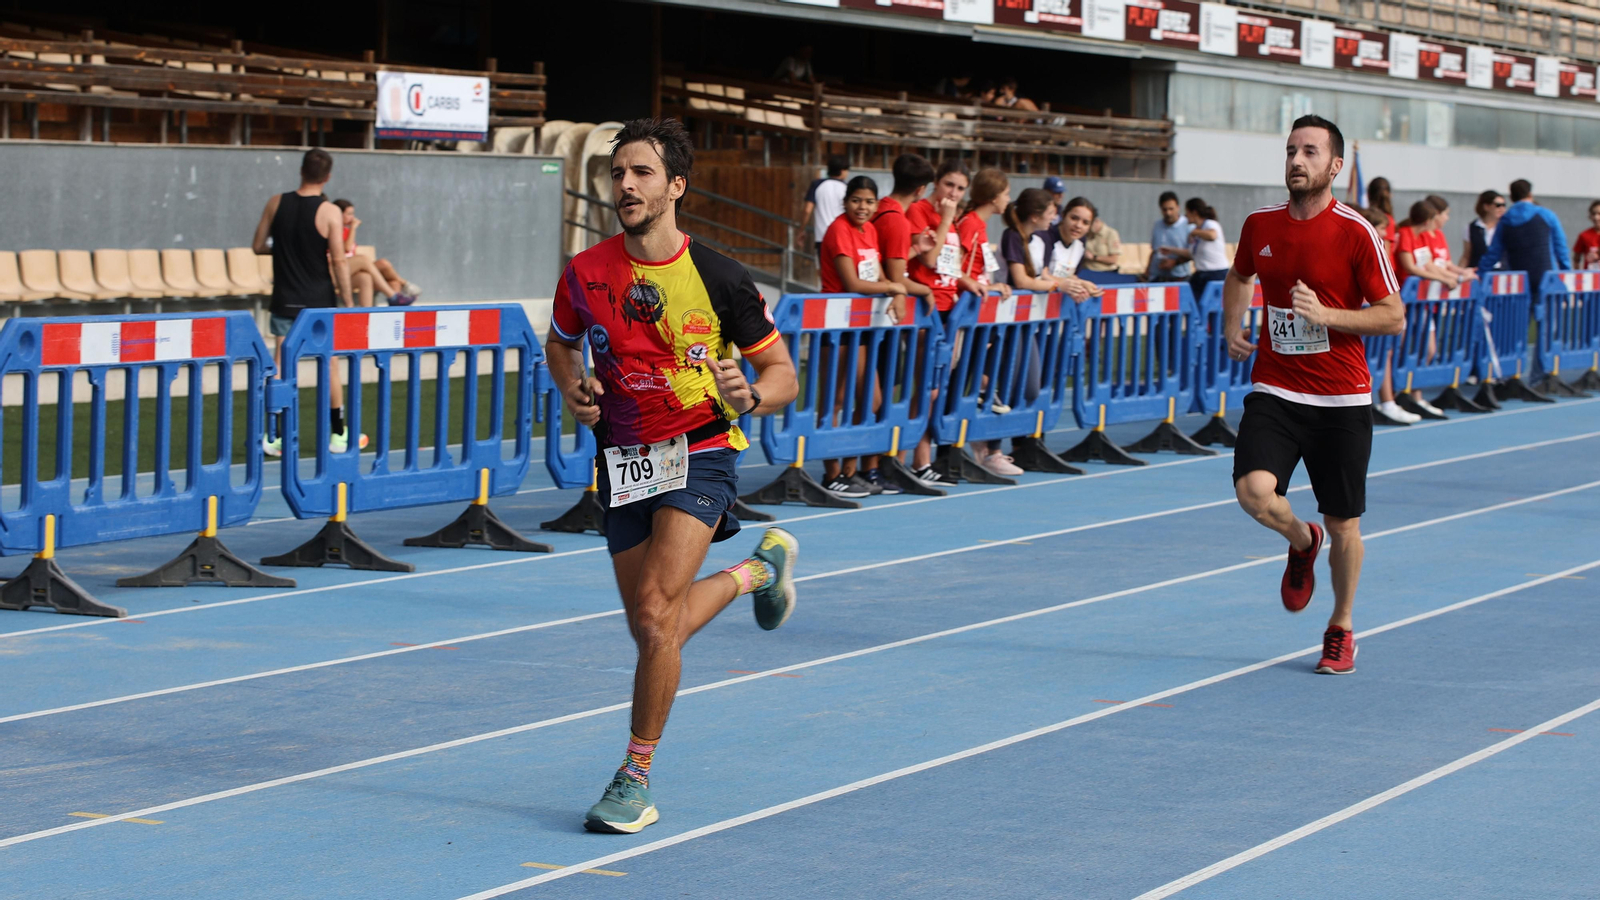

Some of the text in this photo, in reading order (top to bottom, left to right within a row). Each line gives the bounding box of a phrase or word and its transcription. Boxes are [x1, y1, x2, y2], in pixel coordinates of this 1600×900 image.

[428, 96, 460, 110] CARBIS
[1272, 320, 1296, 337] 241
[616, 458, 654, 485] 709
